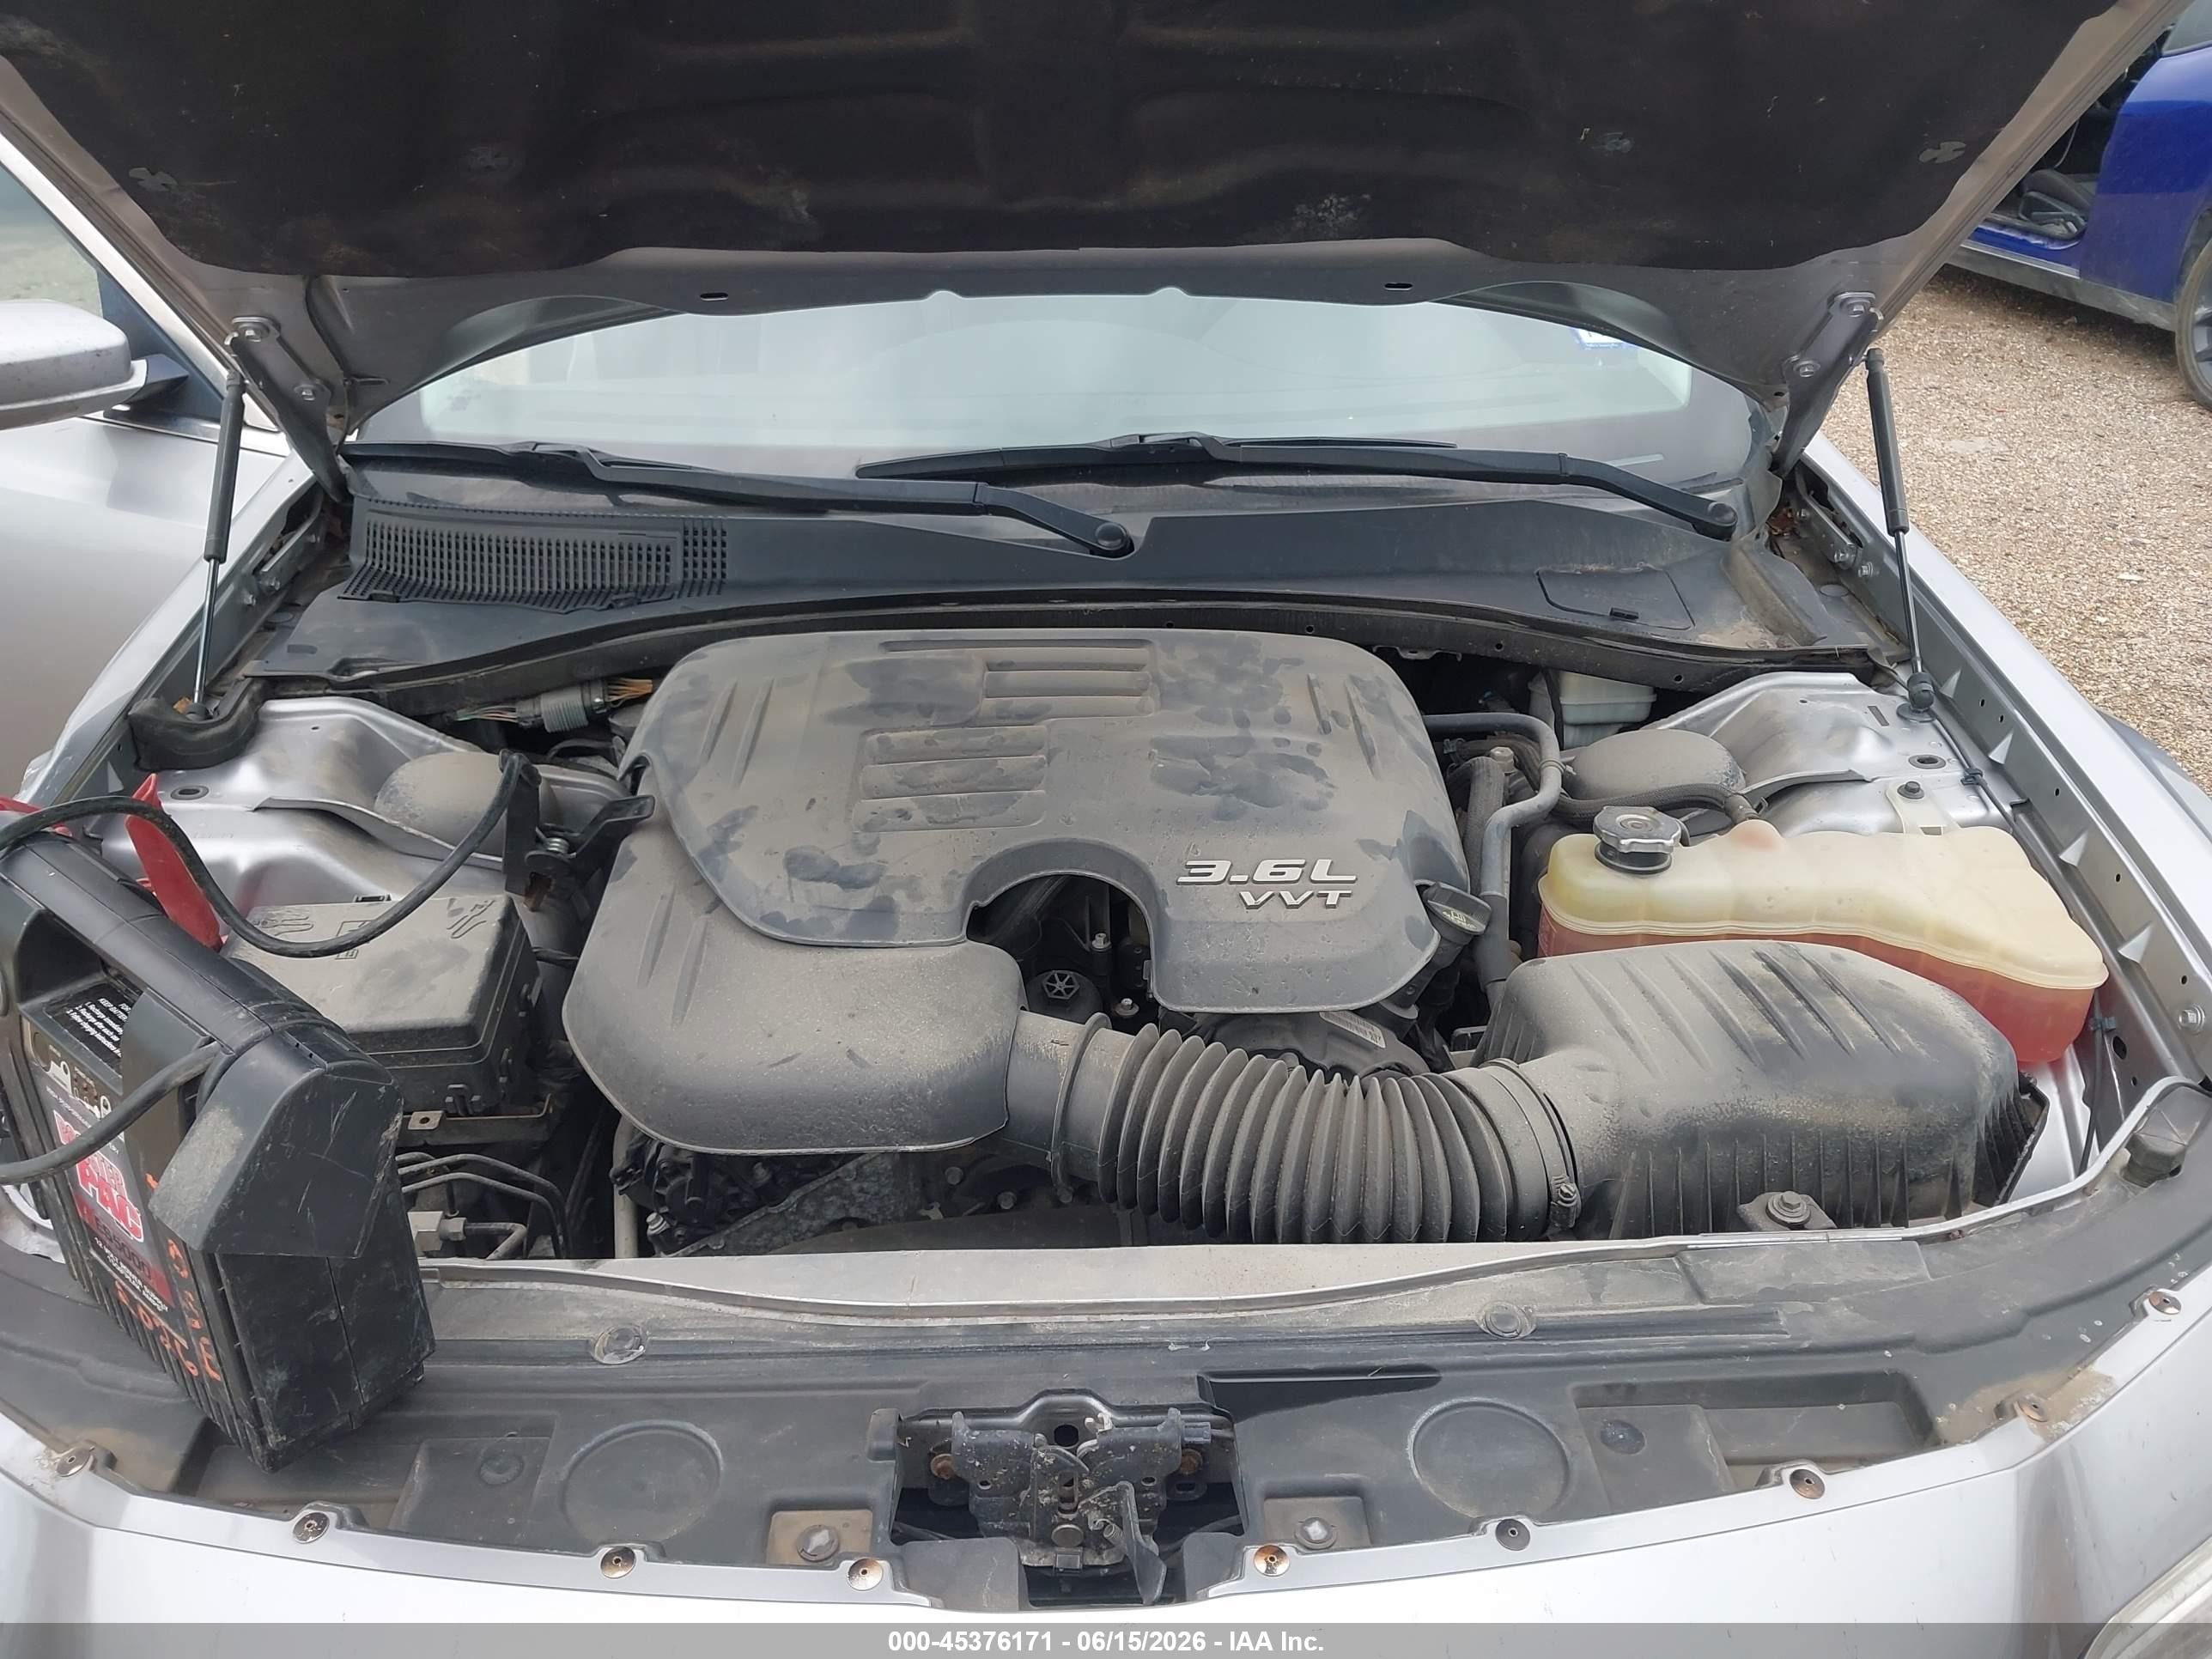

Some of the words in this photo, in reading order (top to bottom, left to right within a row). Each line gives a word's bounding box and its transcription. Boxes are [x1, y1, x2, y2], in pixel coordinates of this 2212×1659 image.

[1176, 860, 1358, 885] 3.6L
[1239, 890, 1352, 909] VVT
[98, 998, 113, 1008] KEEP
[109, 1006, 128, 1022] BATTER
[76, 1157, 144, 1243] PAC
[94, 1237, 103, 1249] 12
